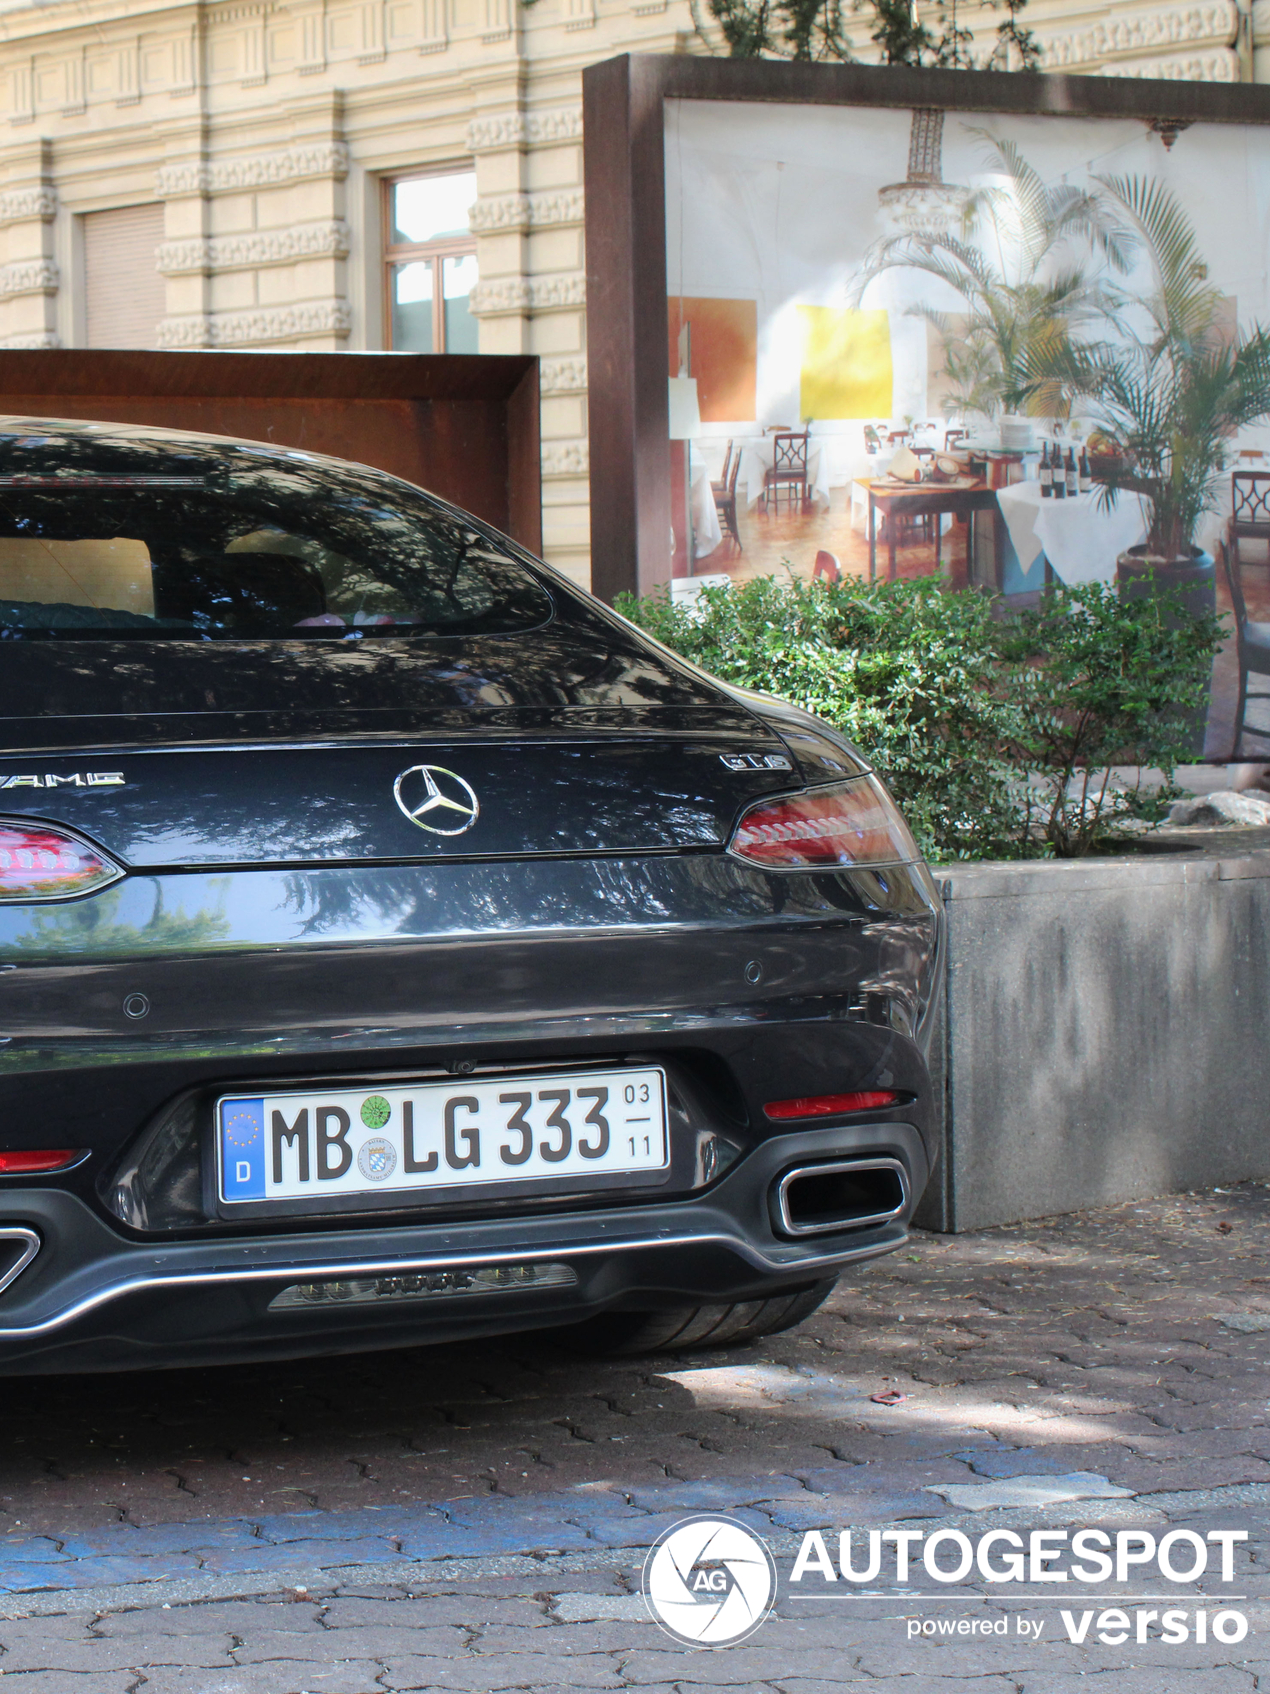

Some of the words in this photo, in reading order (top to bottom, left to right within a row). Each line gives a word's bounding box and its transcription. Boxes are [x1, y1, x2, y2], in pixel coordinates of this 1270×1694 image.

[1, 772, 125, 788] AMG
[624, 1084, 650, 1104] 03
[271, 1105, 353, 1184] MB
[402, 1095, 482, 1174] LG
[497, 1086, 609, 1165] 333
[628, 1135, 650, 1156] 11
[235, 1160, 251, 1182] D
